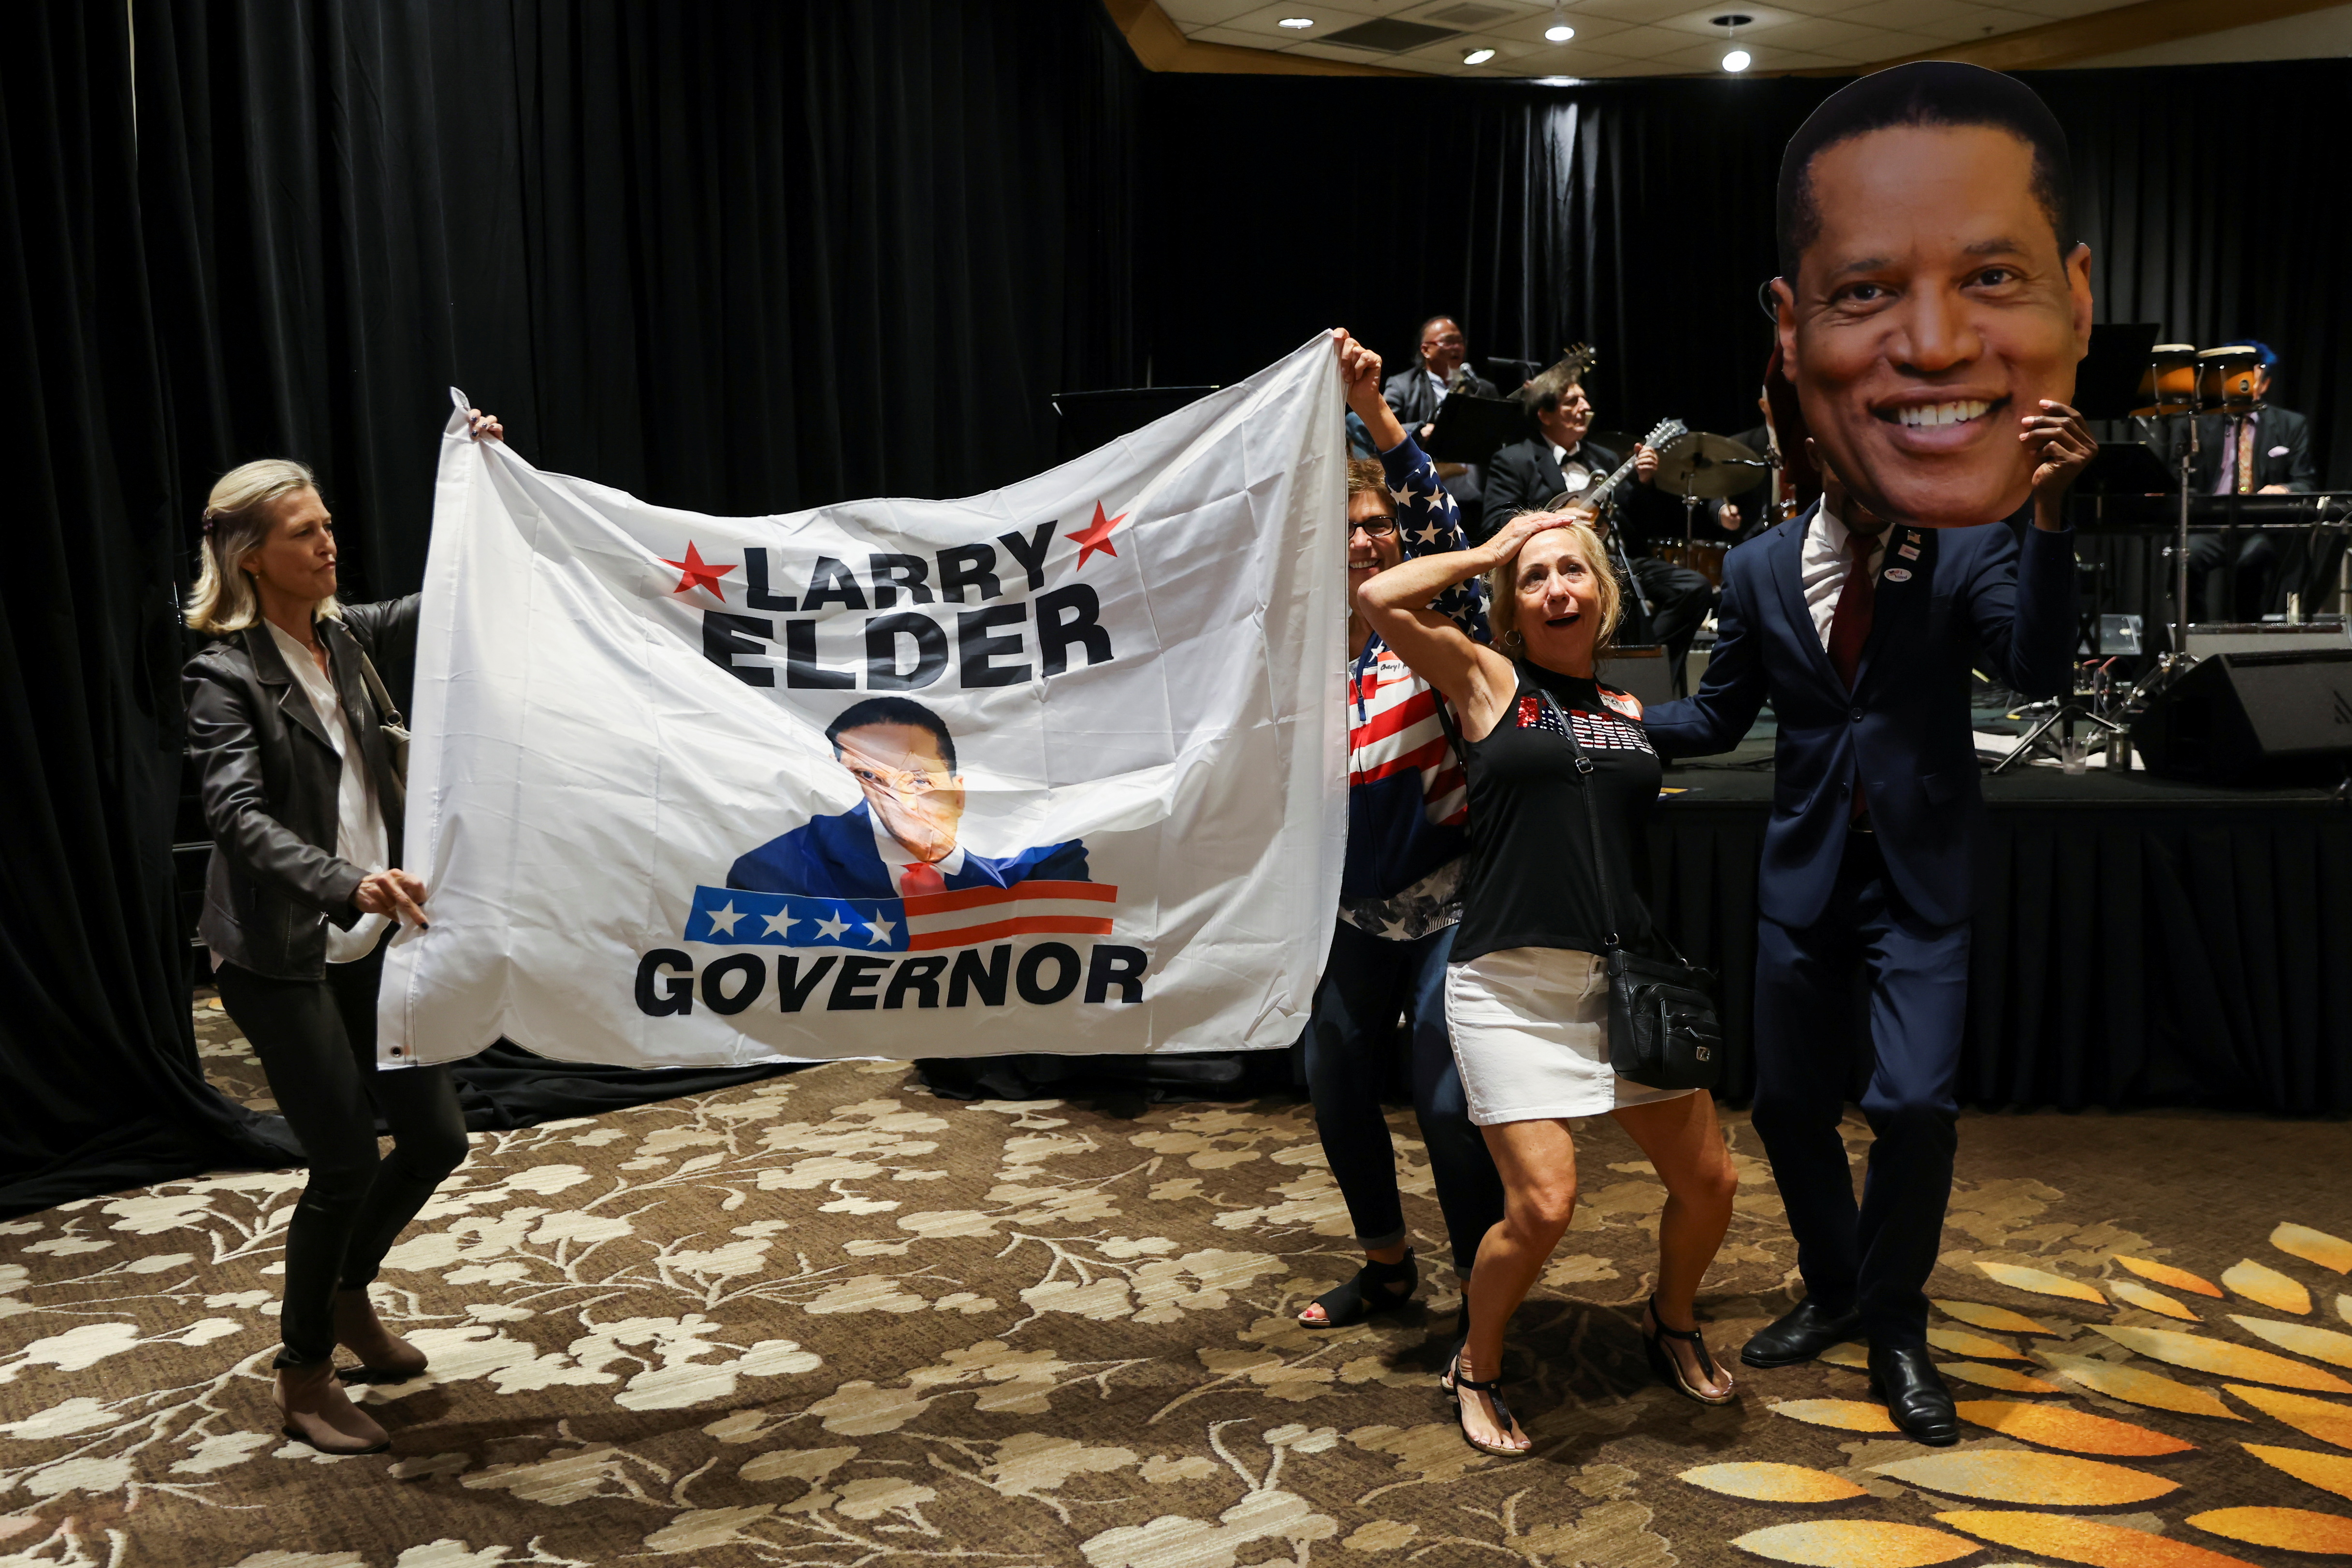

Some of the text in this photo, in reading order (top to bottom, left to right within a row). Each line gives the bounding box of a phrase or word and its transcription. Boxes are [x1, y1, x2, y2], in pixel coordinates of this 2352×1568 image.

[744, 519, 1059, 611] LARRY
[702, 583, 1114, 691] ELDER
[634, 942, 1149, 1016] GOVERNOR
